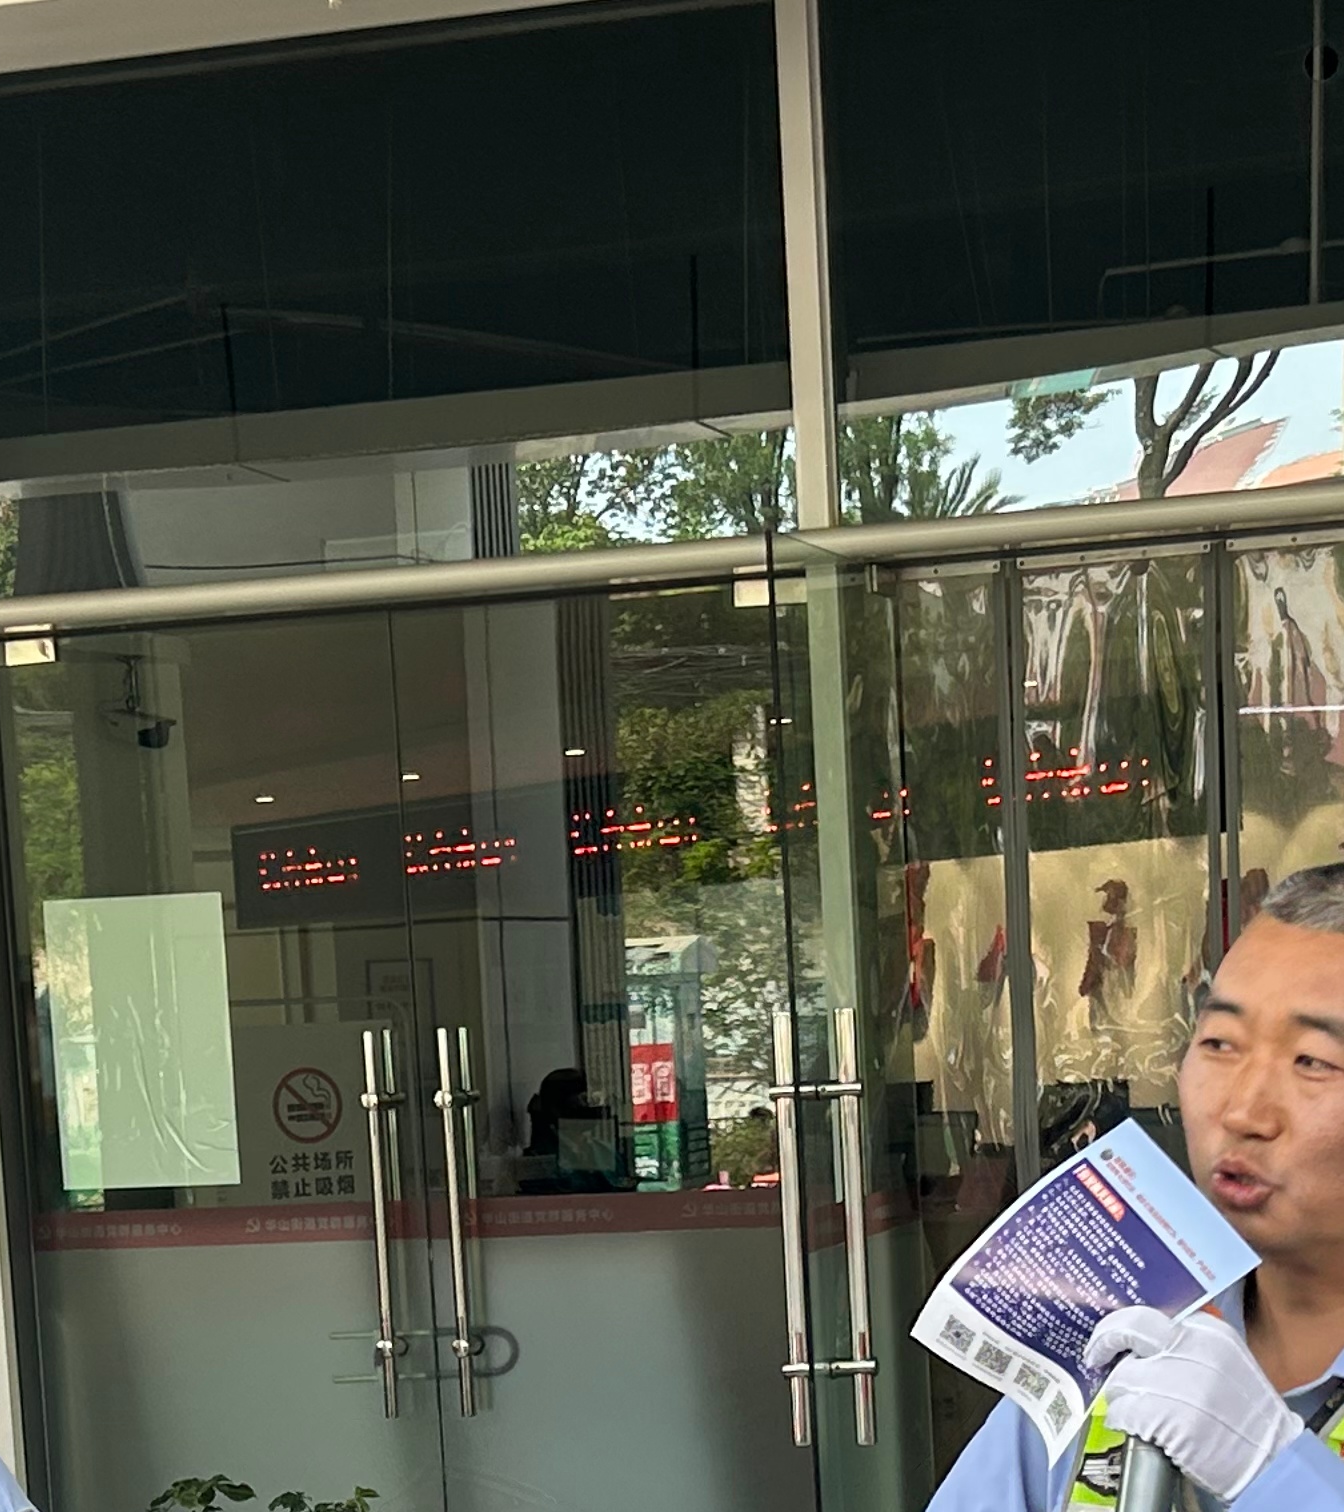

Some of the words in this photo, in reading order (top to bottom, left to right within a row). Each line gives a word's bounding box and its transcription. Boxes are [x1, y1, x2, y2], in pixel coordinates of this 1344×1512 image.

[269, 1150, 354, 1174] 公共场所
[271, 1174, 355, 1200] 禁止吸烟
